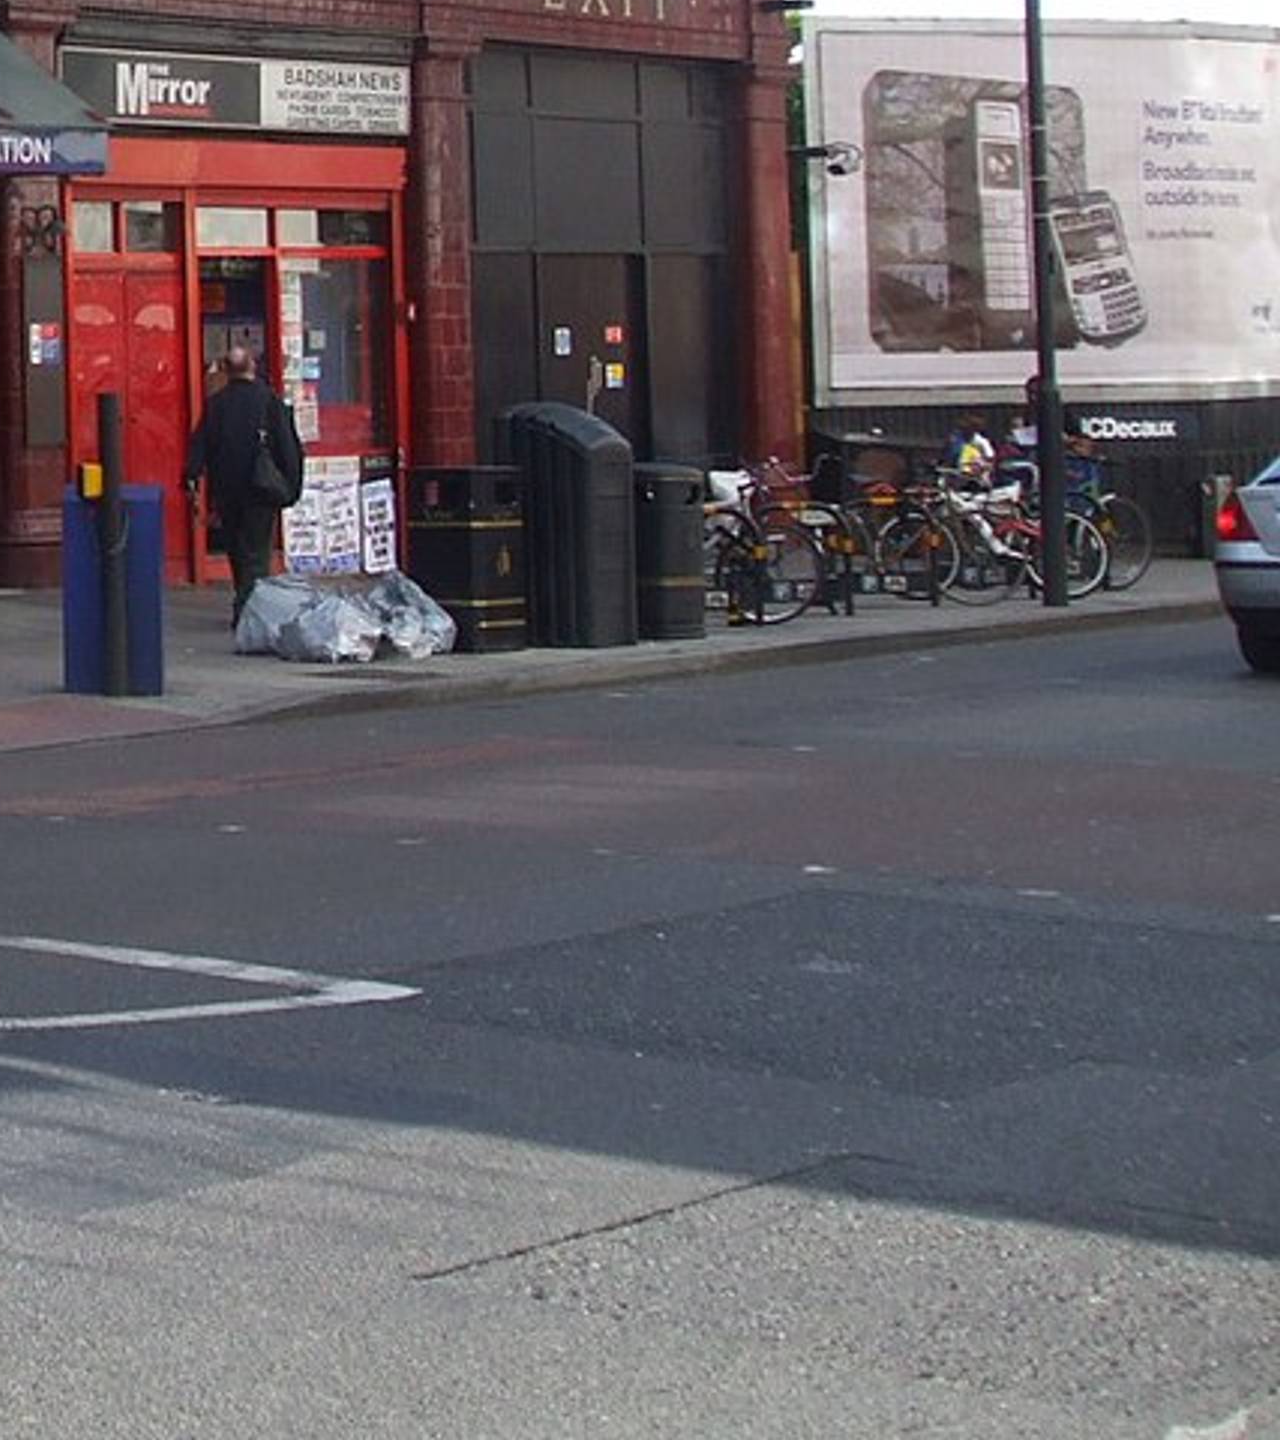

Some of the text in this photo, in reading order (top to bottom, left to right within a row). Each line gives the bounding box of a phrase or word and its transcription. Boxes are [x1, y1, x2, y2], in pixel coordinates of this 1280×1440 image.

[116, 62, 211, 115] Mirror
[284, 68, 402, 92] BADSHAH NEWS
